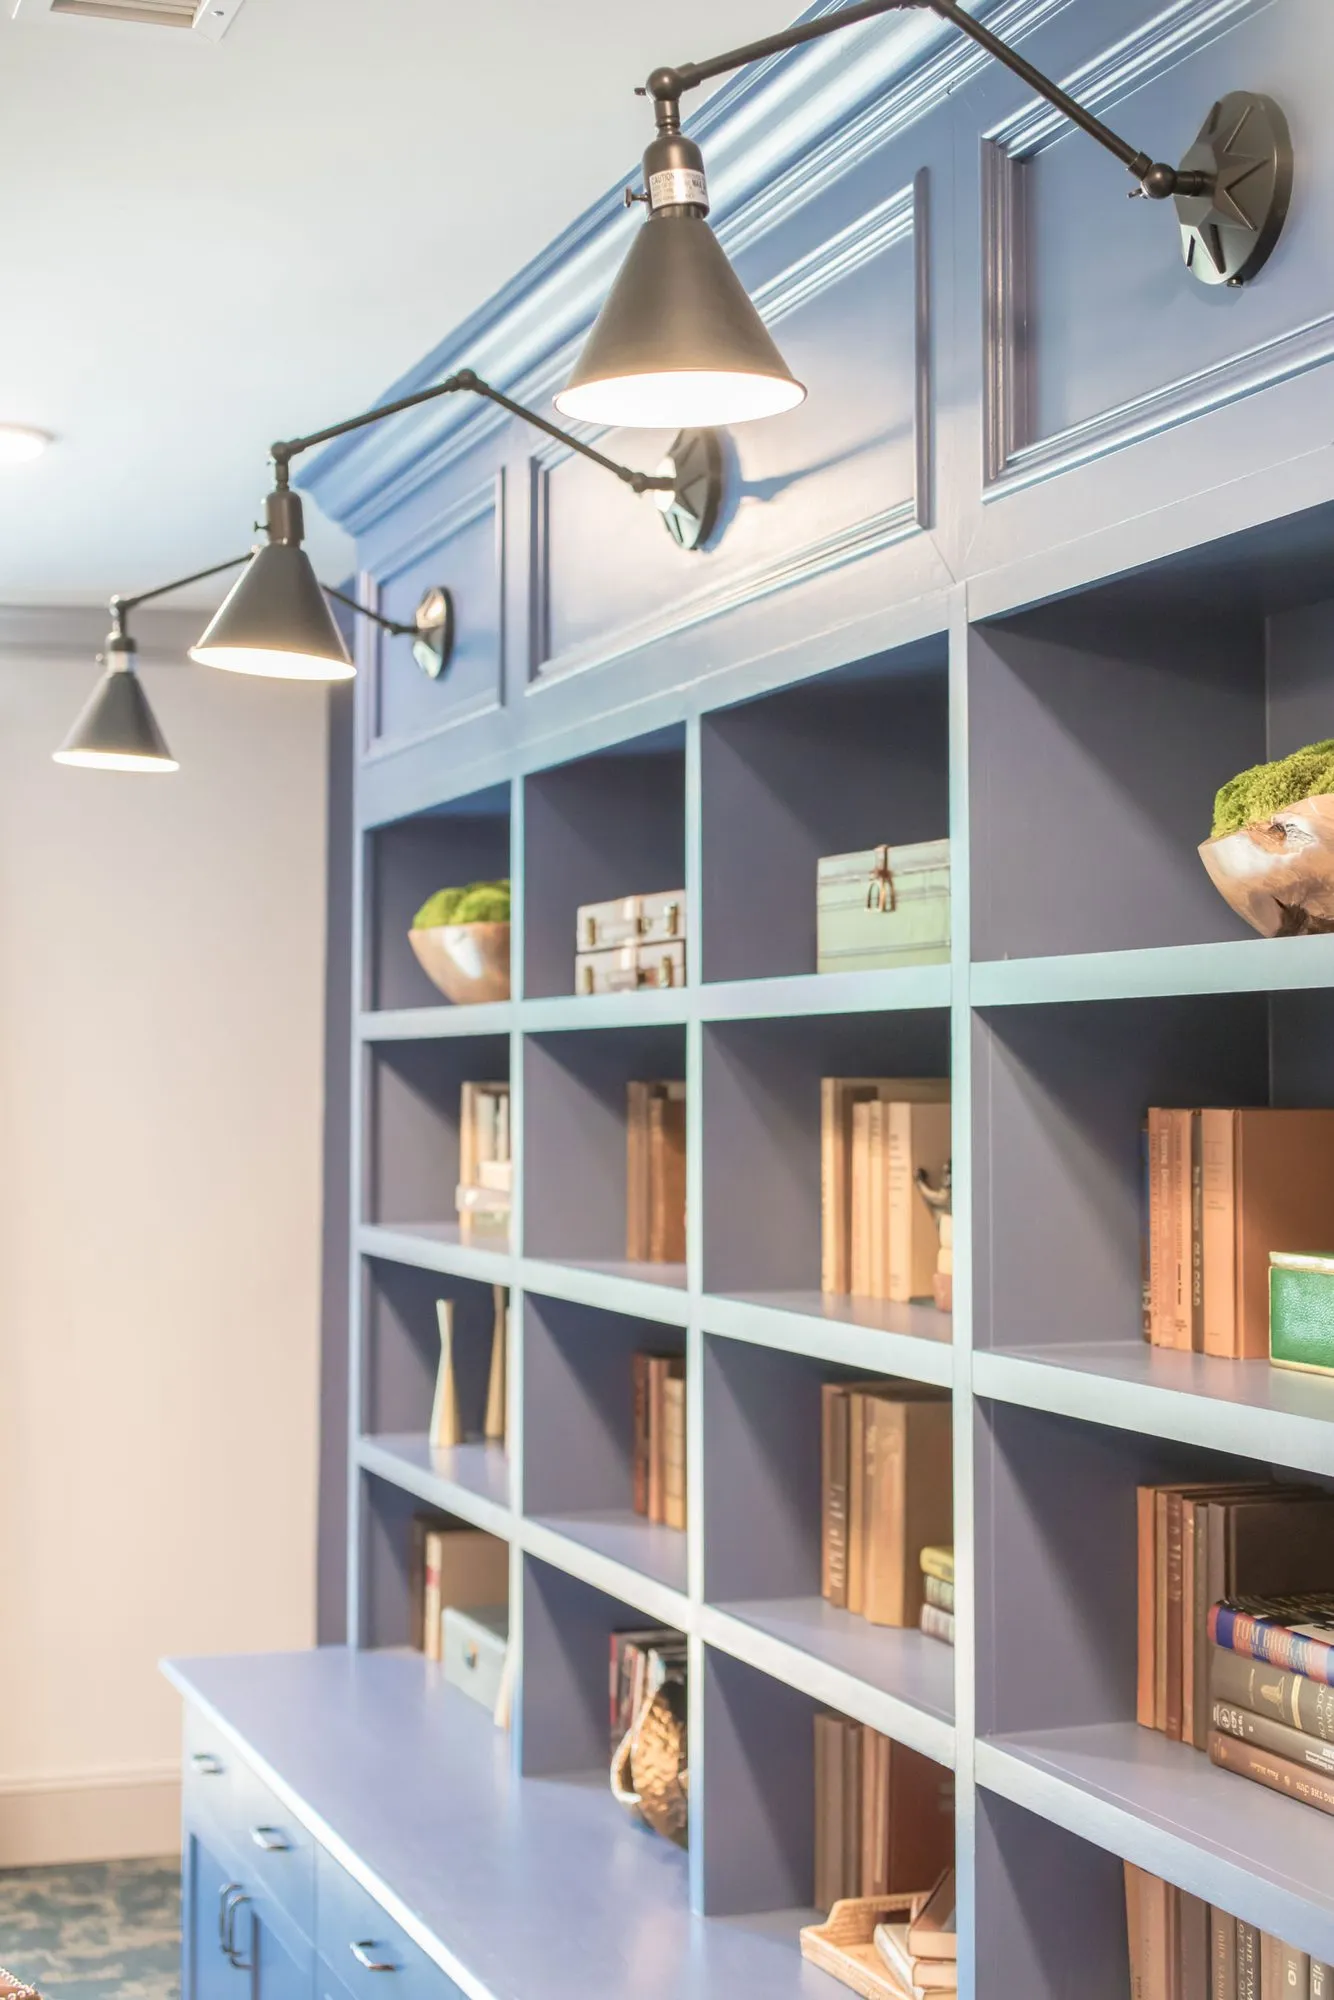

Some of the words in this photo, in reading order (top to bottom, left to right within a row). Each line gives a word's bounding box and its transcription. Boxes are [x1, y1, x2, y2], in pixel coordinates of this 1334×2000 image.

[651, 172, 675, 184] CAUTION
[1193, 1270, 1201, 1306] GOLD
[1235, 1619, 1260, 1645] TOM
[1263, 1627, 1313, 1665] BROKAW
[1217, 1929, 1226, 1959] JOHN
[1239, 1923, 1246, 1943] OF
[1246, 1933, 1254, 1963] THE
